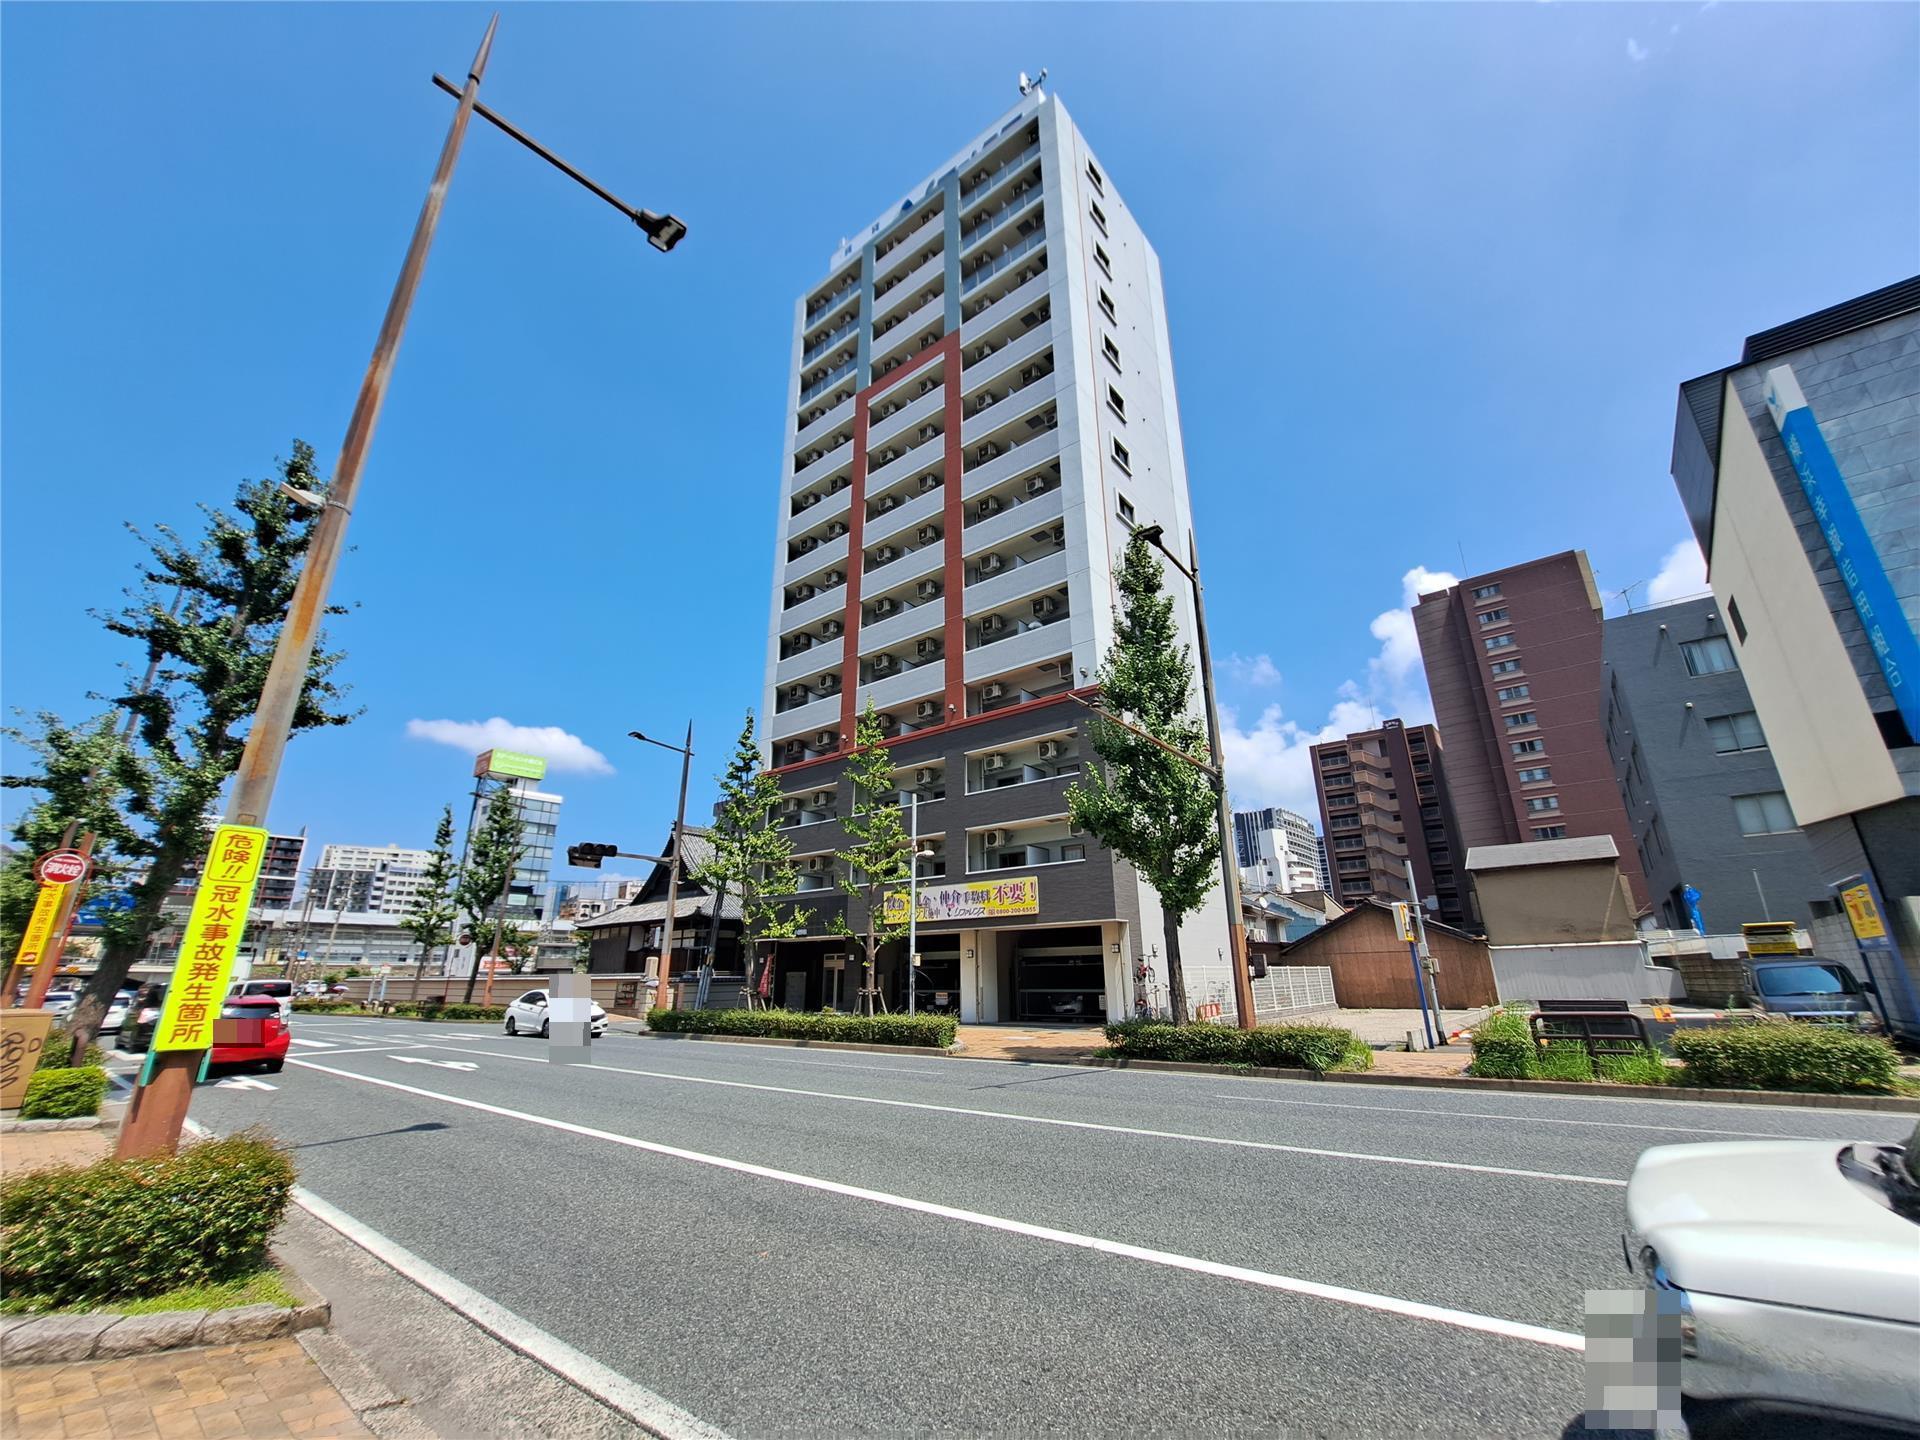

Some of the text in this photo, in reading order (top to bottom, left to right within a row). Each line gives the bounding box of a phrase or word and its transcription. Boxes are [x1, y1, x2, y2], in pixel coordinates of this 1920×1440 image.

[45, 862, 82, 876] 消火栓
[886, 906, 941, 920] キャンペン実施中
[168, 885, 242, 1044] 冠水事故発生箇所
